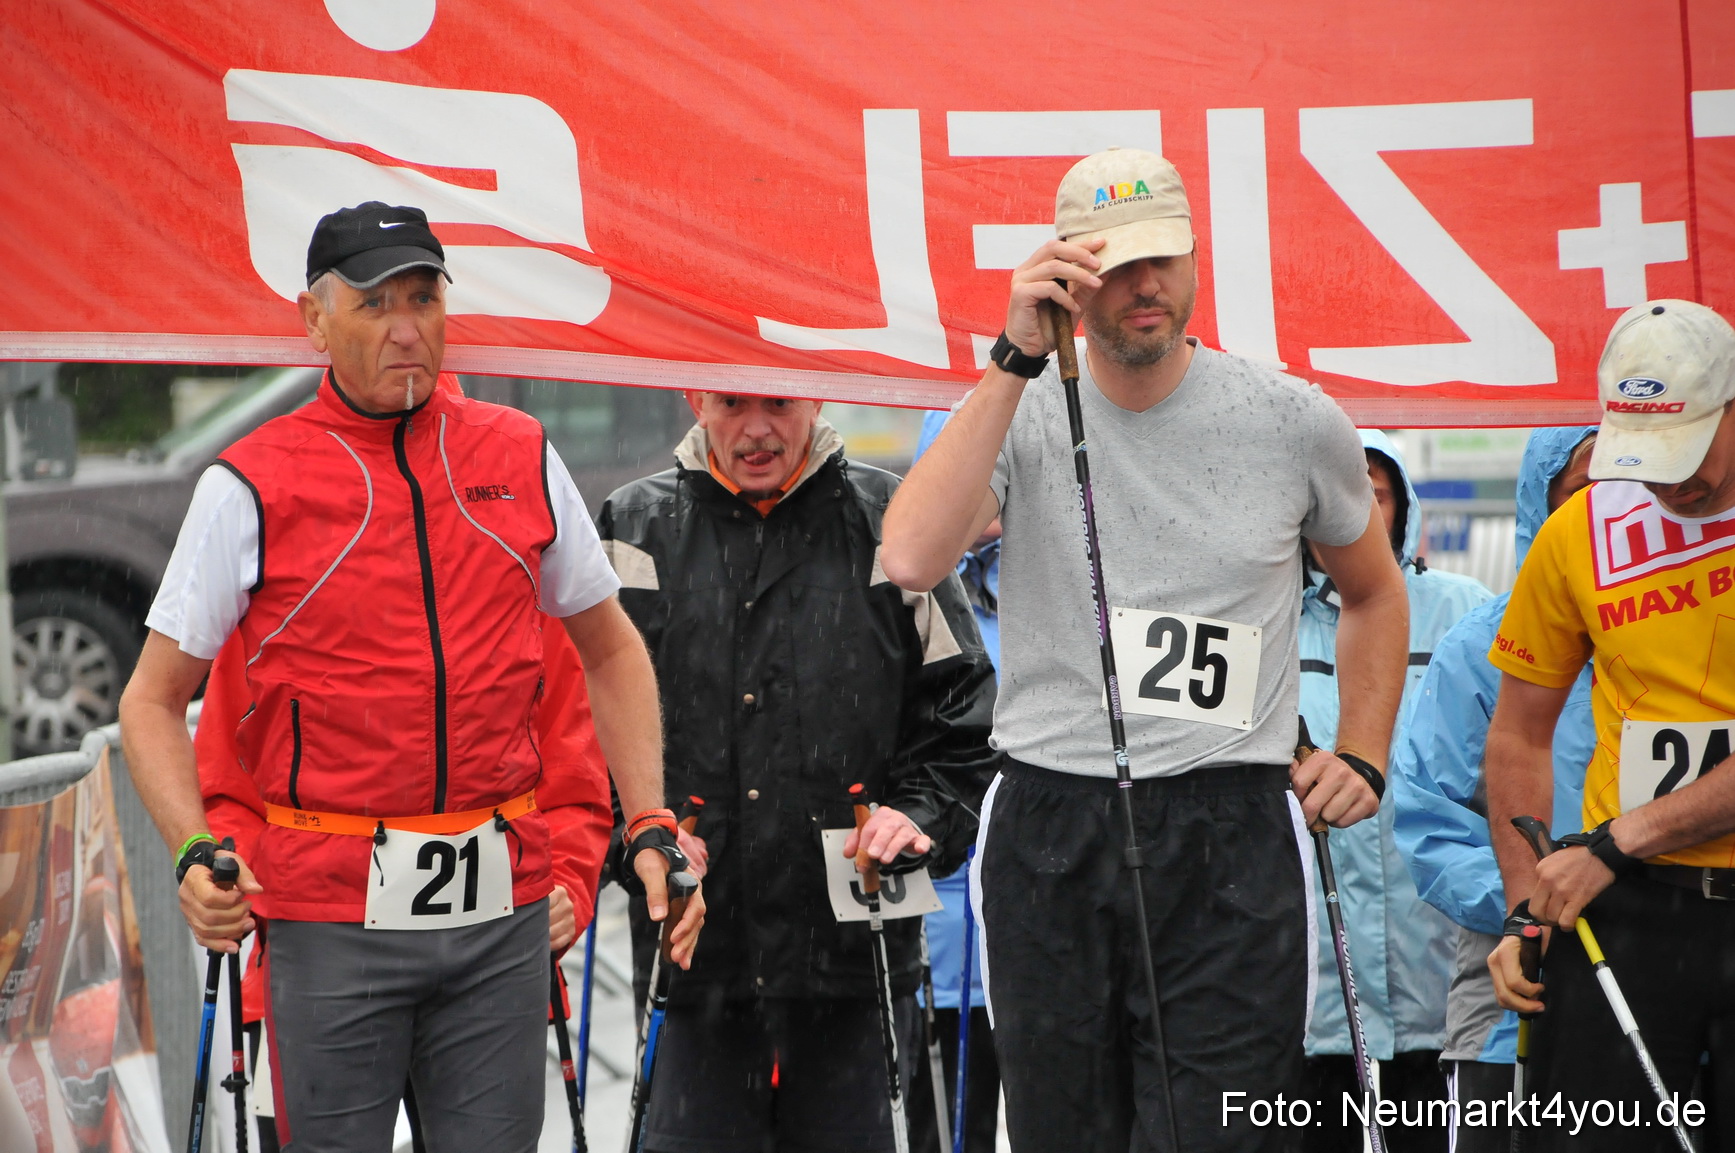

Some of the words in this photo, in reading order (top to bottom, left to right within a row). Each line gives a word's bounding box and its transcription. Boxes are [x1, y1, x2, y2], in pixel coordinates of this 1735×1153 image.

[1094, 180, 1150, 205] AIDA
[1623, 380, 1656, 396] Ford
[1606, 401, 1686, 414] RACING
[465, 485, 510, 502] RUNNER'S
[1597, 579, 1701, 632] MAX
[1708, 565, 1735, 599] B
[1138, 616, 1230, 710] 25
[1108, 675, 1122, 721] CARBON
[411, 834, 480, 916] 21
